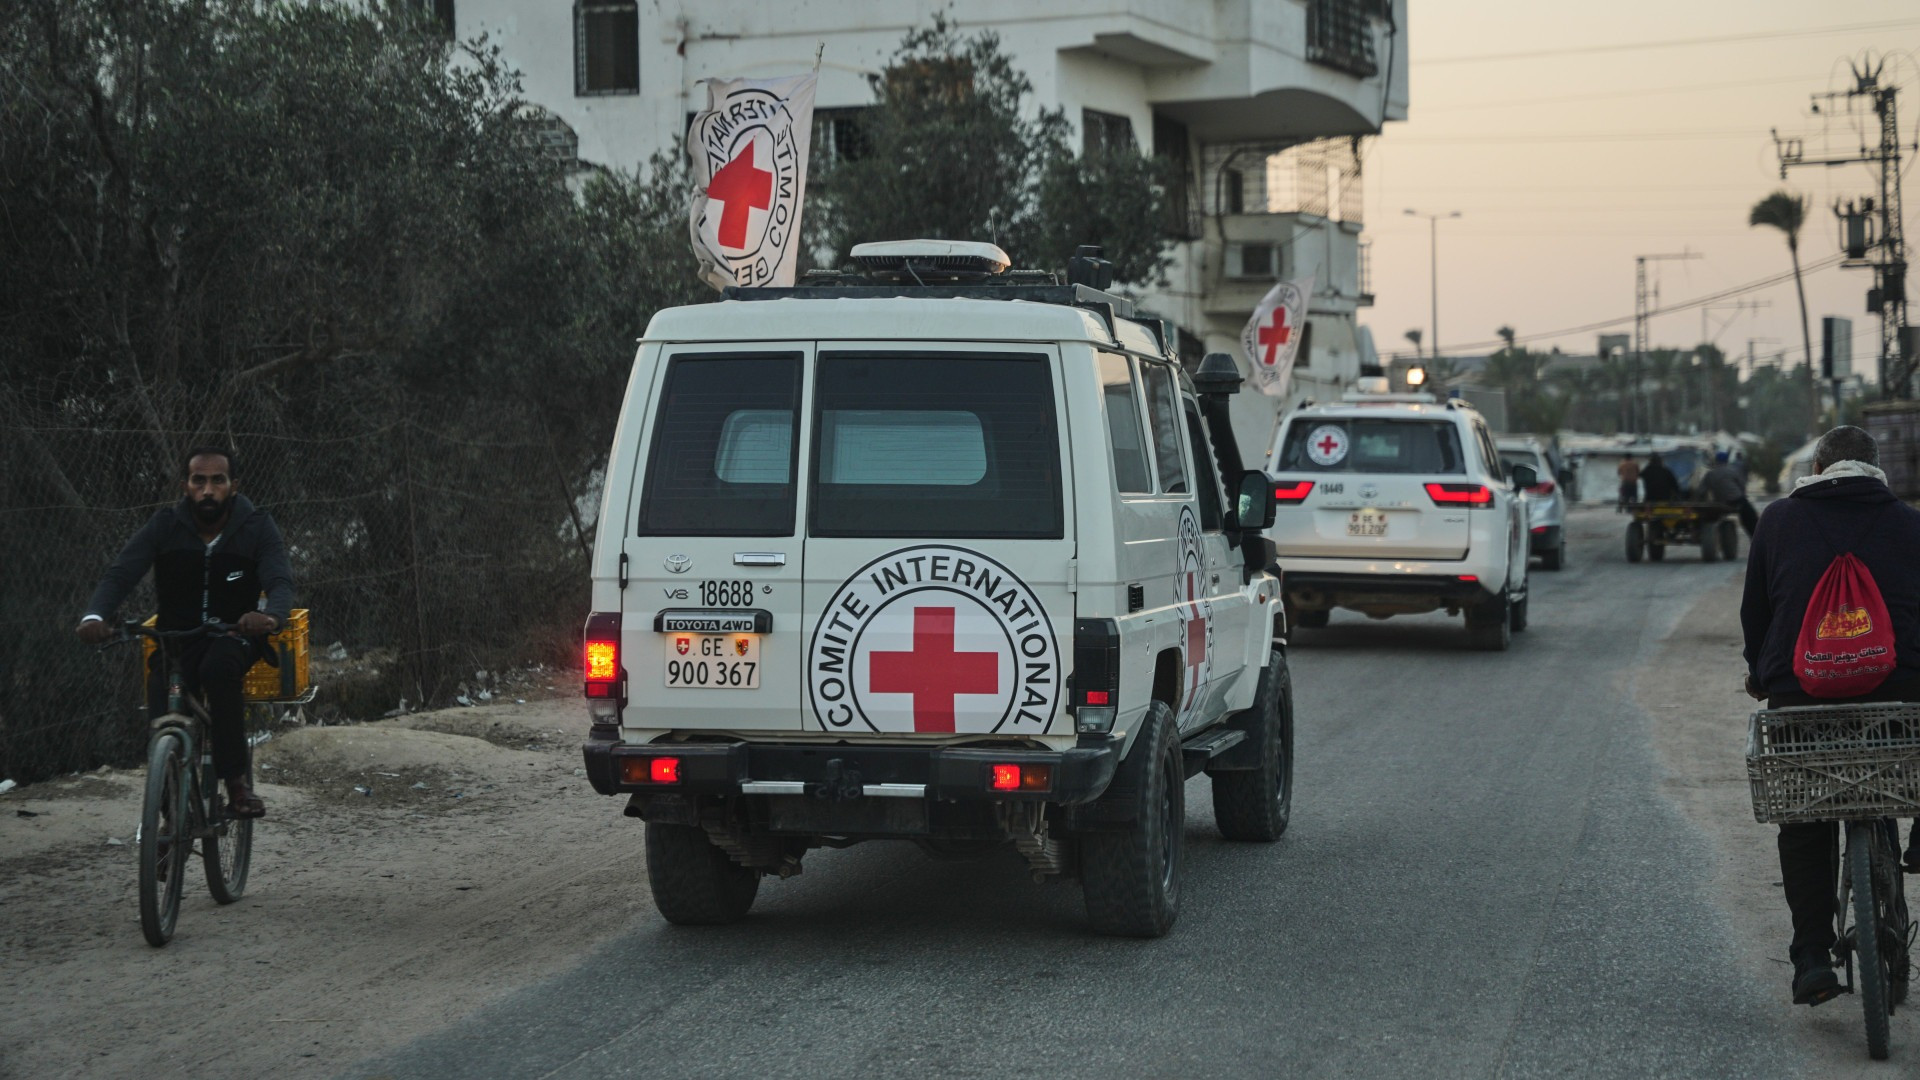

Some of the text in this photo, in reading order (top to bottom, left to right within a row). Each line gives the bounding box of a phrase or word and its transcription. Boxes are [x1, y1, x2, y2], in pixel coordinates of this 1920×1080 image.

[664, 588, 689, 600] V8
[698, 580, 754, 607] 18688
[668, 620, 753, 631] TOYOTA 4WD
[701, 638, 724, 657] GE
[818, 555, 1051, 728] COMITE INTERNATIONAL
[668, 660, 757, 686] 900 367
